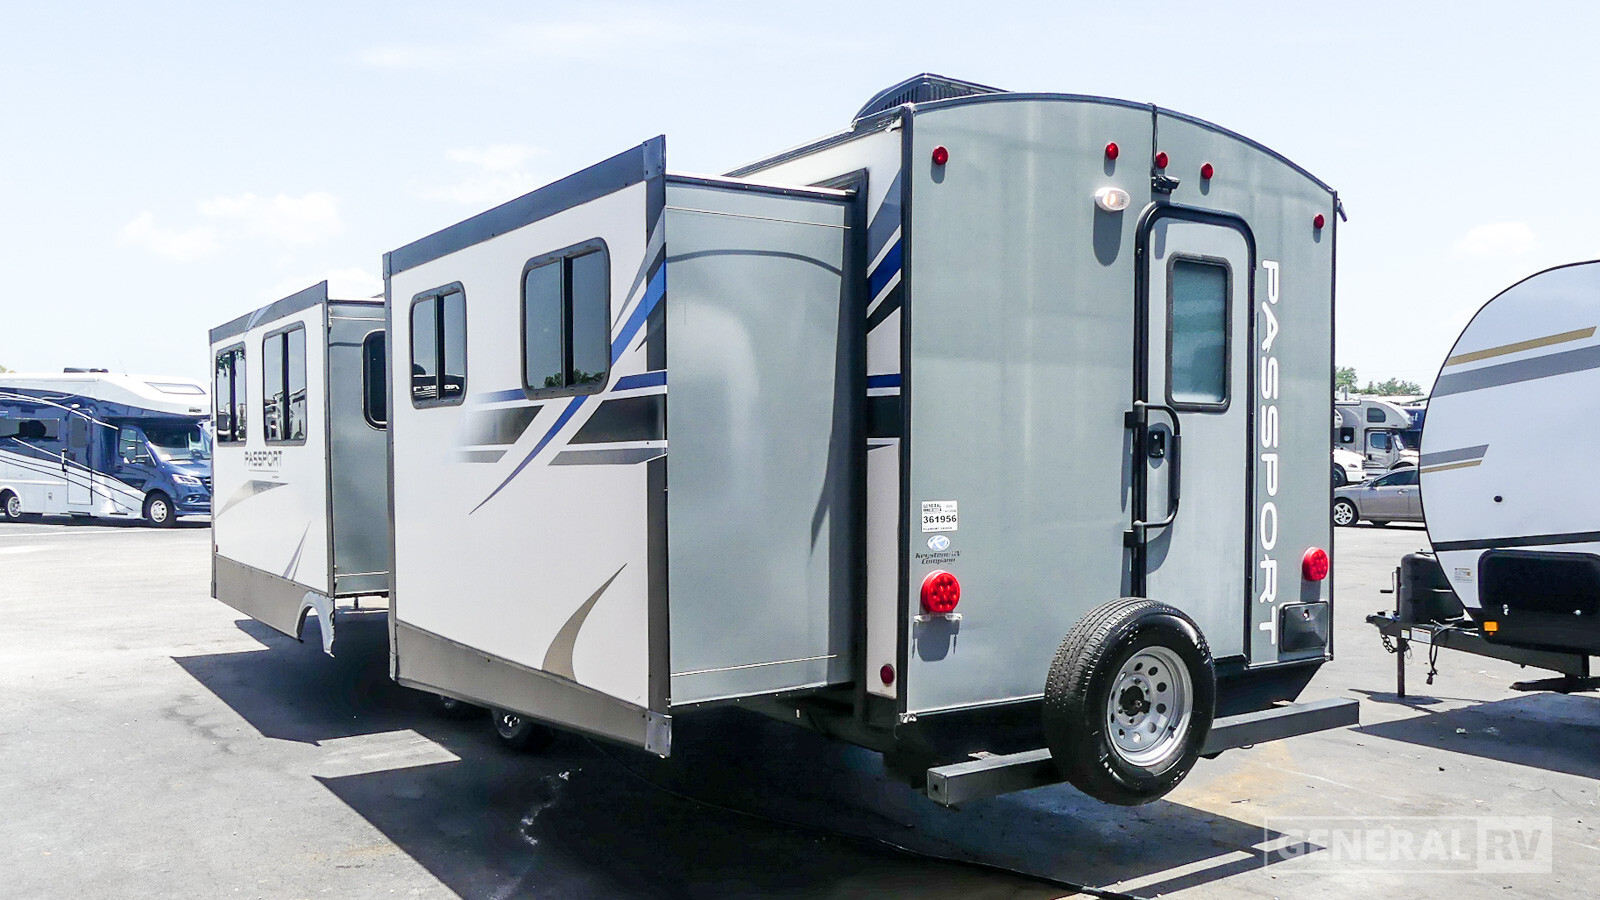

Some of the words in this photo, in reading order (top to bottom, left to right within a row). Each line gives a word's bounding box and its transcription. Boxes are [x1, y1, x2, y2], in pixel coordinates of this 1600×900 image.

[1259, 259, 1280, 646] PASSPORT
[245, 451, 282, 467] PASSPORT
[923, 515, 957, 524] 361956
[915, 552, 950, 560] Keystone
